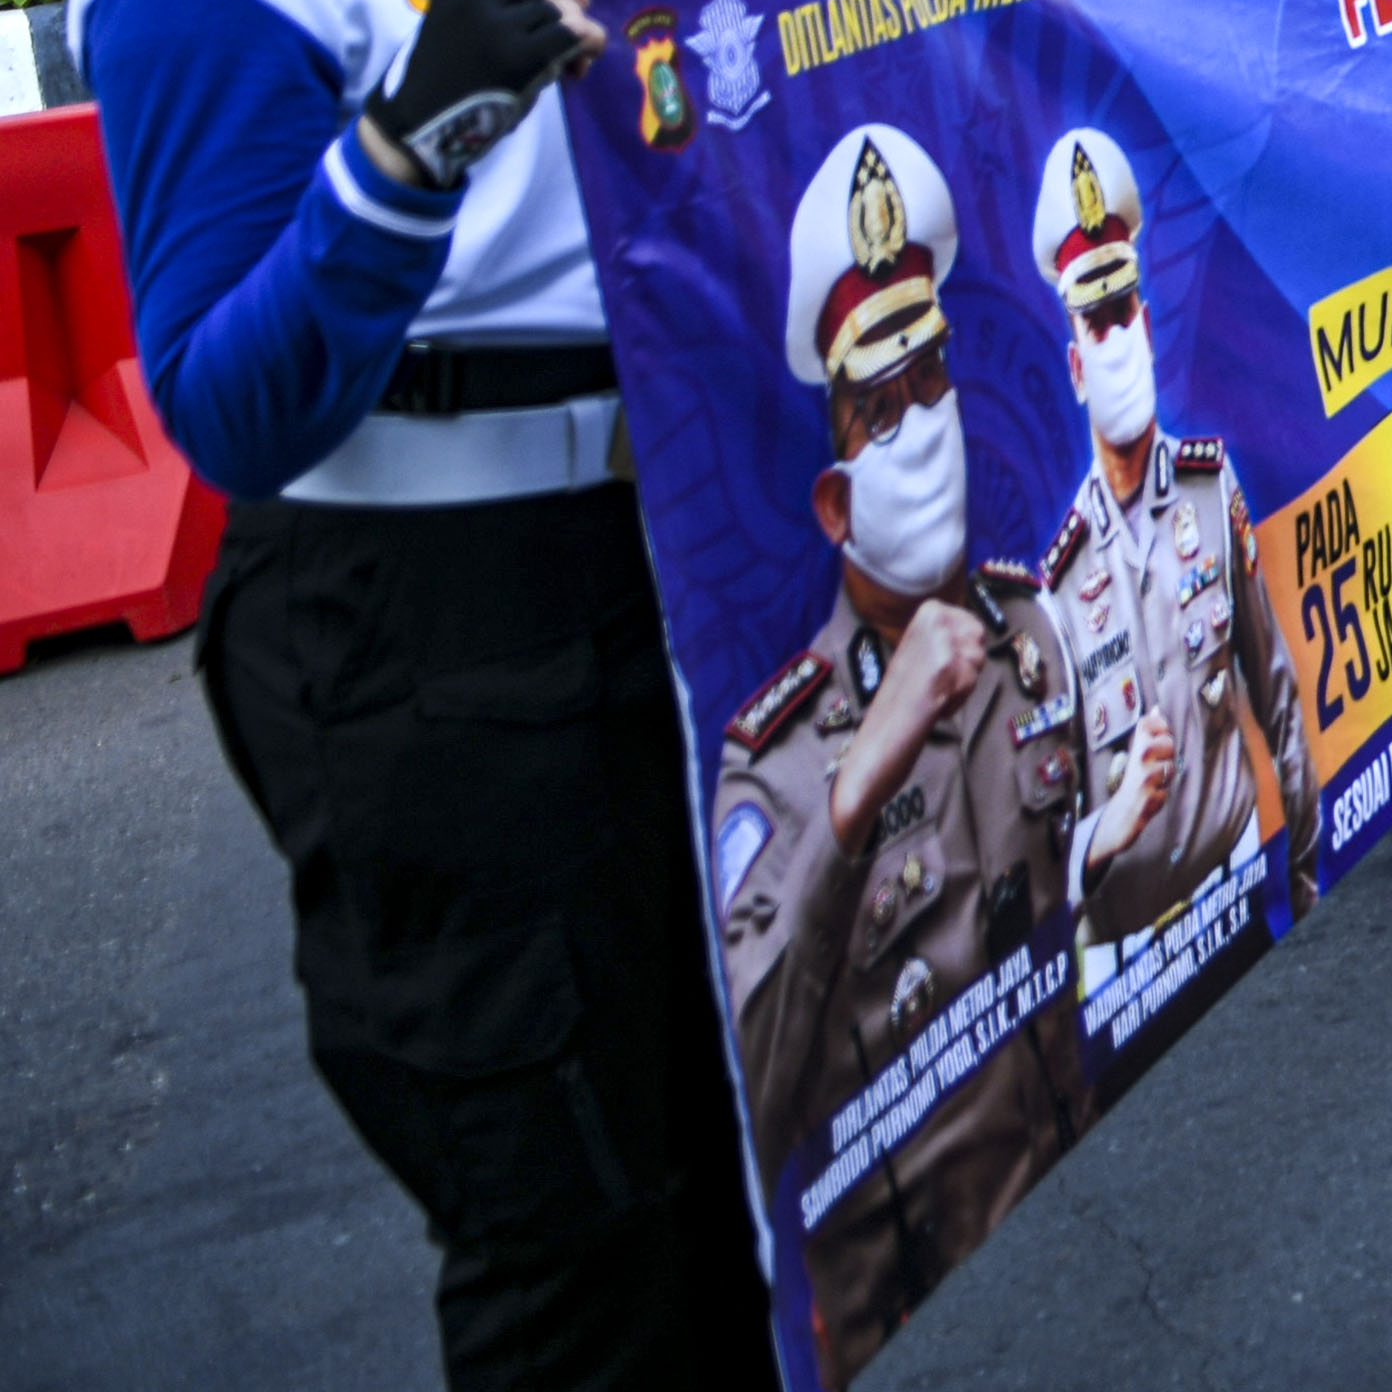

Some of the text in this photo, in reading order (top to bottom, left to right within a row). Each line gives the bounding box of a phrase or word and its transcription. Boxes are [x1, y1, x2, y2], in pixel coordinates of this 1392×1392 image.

[1296, 478, 1360, 589] PADA
[1302, 556, 1371, 732] 25
[1332, 751, 1390, 851] SESUAI
[832, 943, 1031, 1154] DIRLANTAS POLDA METRO JAYA
[1112, 998, 1142, 1049] HARI
